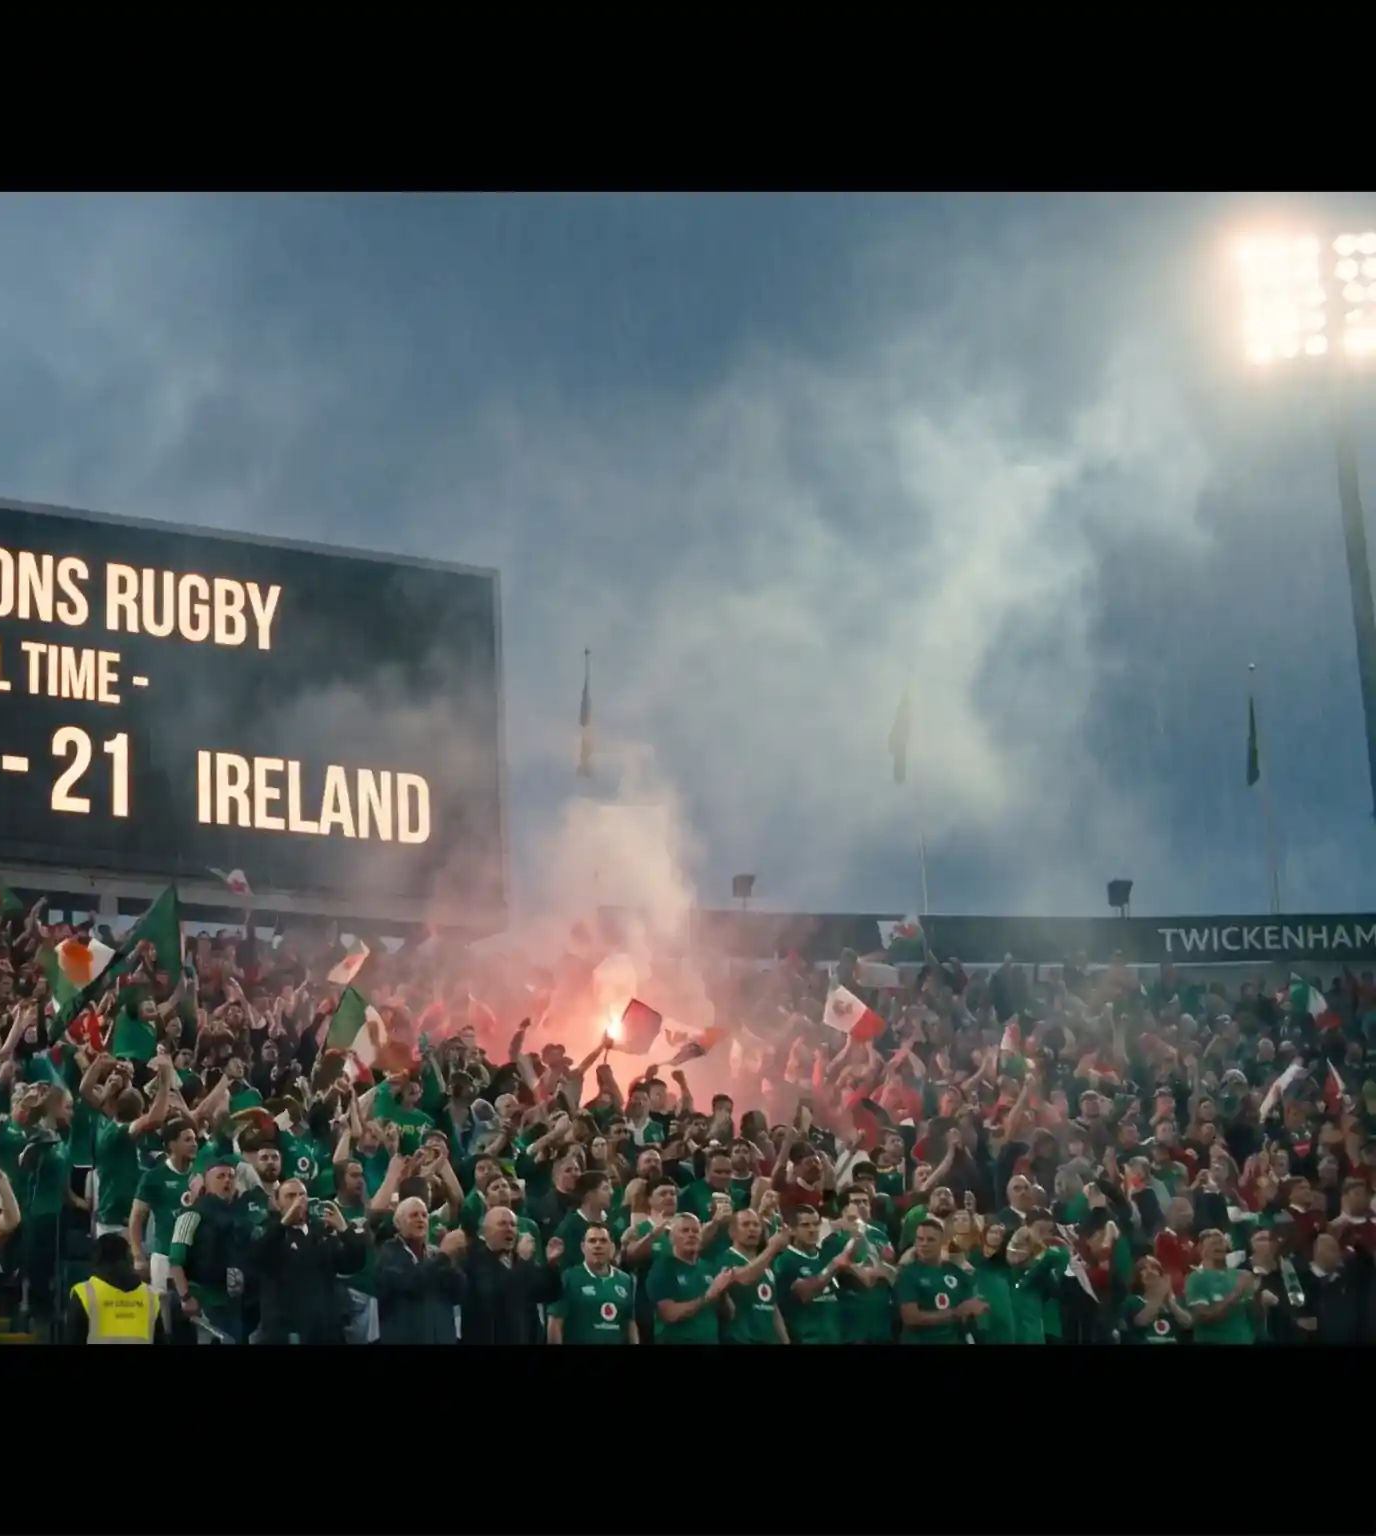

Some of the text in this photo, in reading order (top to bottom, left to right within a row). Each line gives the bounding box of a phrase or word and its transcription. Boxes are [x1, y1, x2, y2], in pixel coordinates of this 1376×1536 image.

[106, 562, 282, 650] RUGBY
[21, 641, 121, 705] TIME
[51, 726, 129, 817] 21
[197, 749, 432, 845] IRELAND
[1157, 923, 1376, 952] TWICKENHAM
